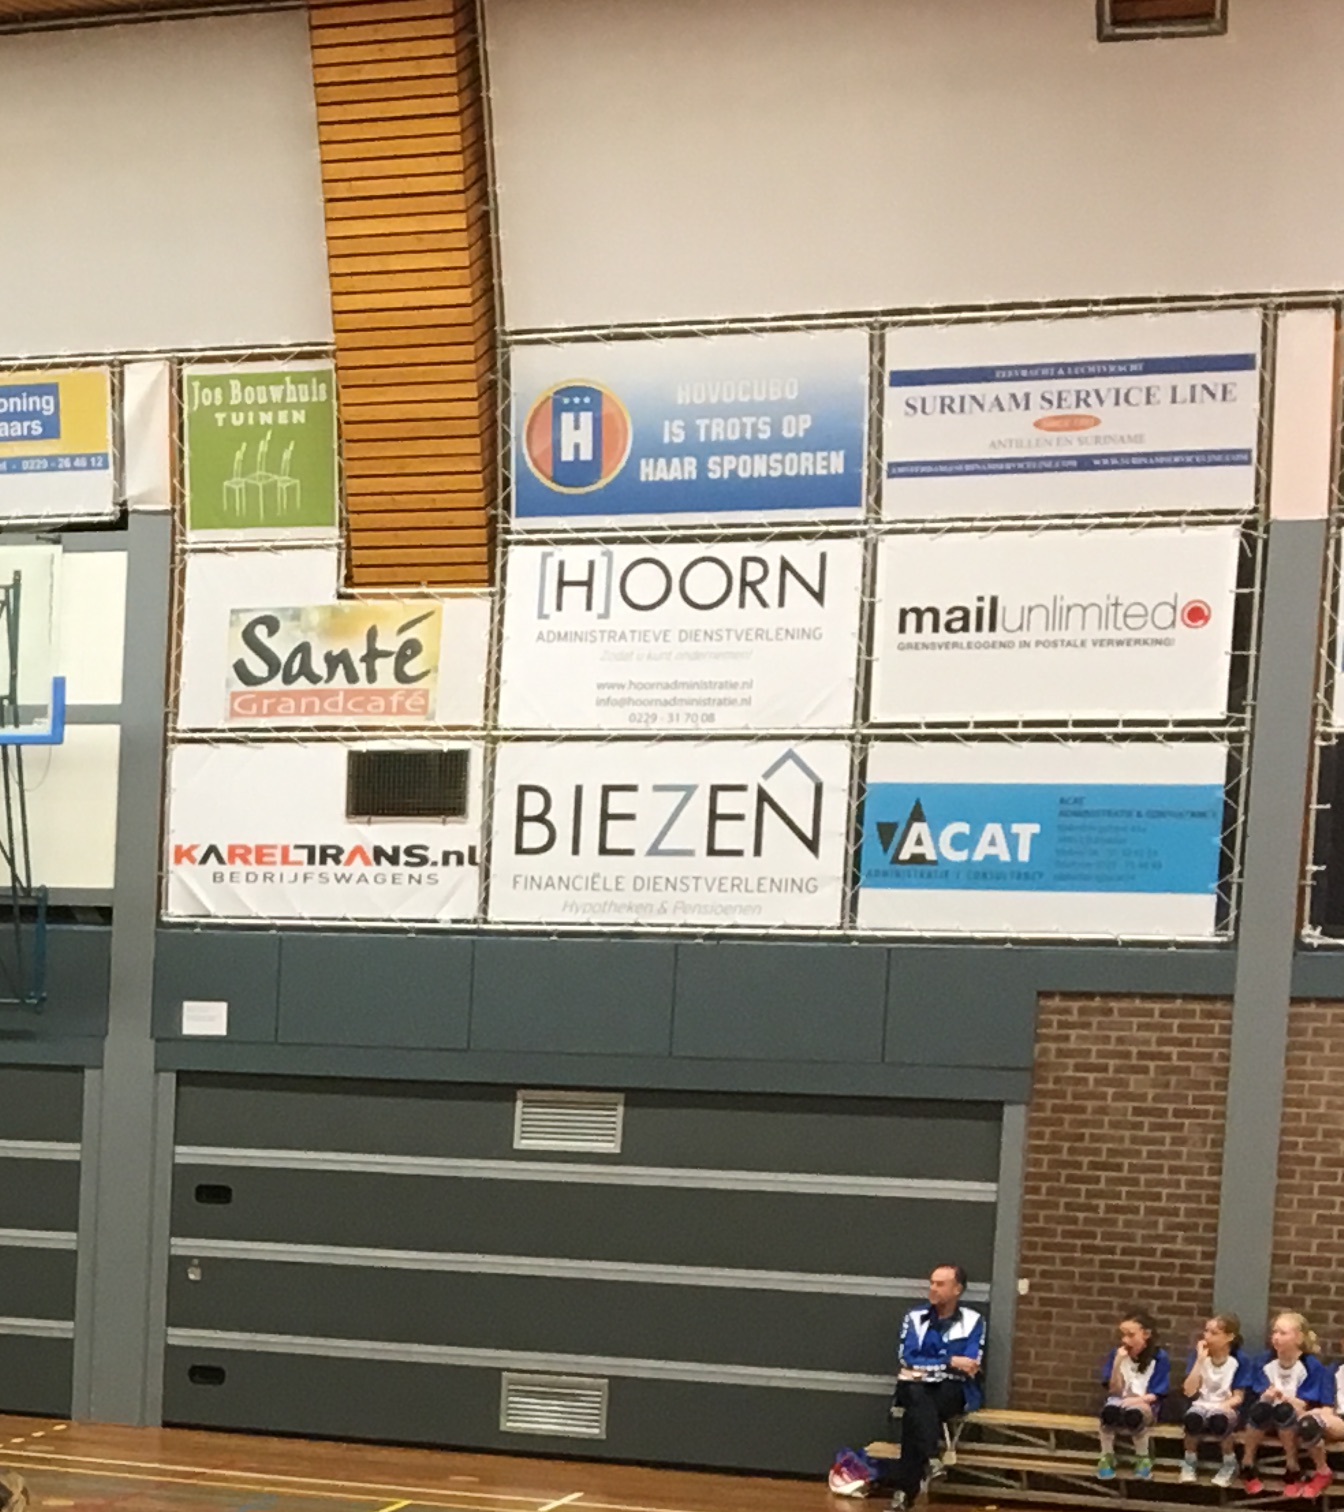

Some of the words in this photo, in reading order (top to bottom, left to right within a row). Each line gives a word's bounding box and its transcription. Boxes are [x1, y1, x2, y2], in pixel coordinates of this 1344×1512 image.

[192, 381, 223, 411] Jos
[229, 376, 327, 405] Bouwhuis
[677, 379, 798, 405] HOVOCUBO
[904, 391, 1031, 417] SURINAM
[1039, 385, 1161, 411] SERVICE
[1169, 382, 1238, 404] LINE
[215, 410, 305, 426] TUINEN
[663, 419, 685, 443] IS
[696, 416, 770, 441] TROTS
[782, 414, 811, 438] OP
[561, 411, 593, 461] H
[988, 437, 1053, 450] ANTILLEN
[1056, 436, 1072, 448] EN
[1077, 434, 1146, 447] SURINAME
[90, 456, 103, 467] 12
[639, 457, 697, 482] HAAR
[708, 450, 845, 480] SPONSOREN
[537, 550, 827, 620] [H]OORN
[898, 593, 1178, 635] mailunlimited
[232, 610, 436, 687] Santé
[535, 629, 672, 644] ADMINISTRATIEVE
[678, 627, 823, 643] DIENSTVERLENING
[897, 639, 1015, 651] GRENSVERLEGGEND
[1019, 640, 1031, 649] IN
[1035, 639, 1087, 649] POSTALE
[596, 679, 753, 690] www.hoornadministratie.nl
[233, 689, 426, 715] Grandcafé
[595, 696, 752, 708] info@hoornadministratie.nl
[629, 713, 657, 723] 0229
[514, 783, 823, 859] BIEZEN
[898, 822, 1041, 863] ACAT
[212, 871, 439, 886] BEDRIJFSWAGENS
[512, 873, 625, 892] FINANCIËLE
[633, 876, 819, 894] DIENSTVERLENING
[562, 900, 654, 916] Hypotheken
[673, 900, 761, 915] Pensioenen
